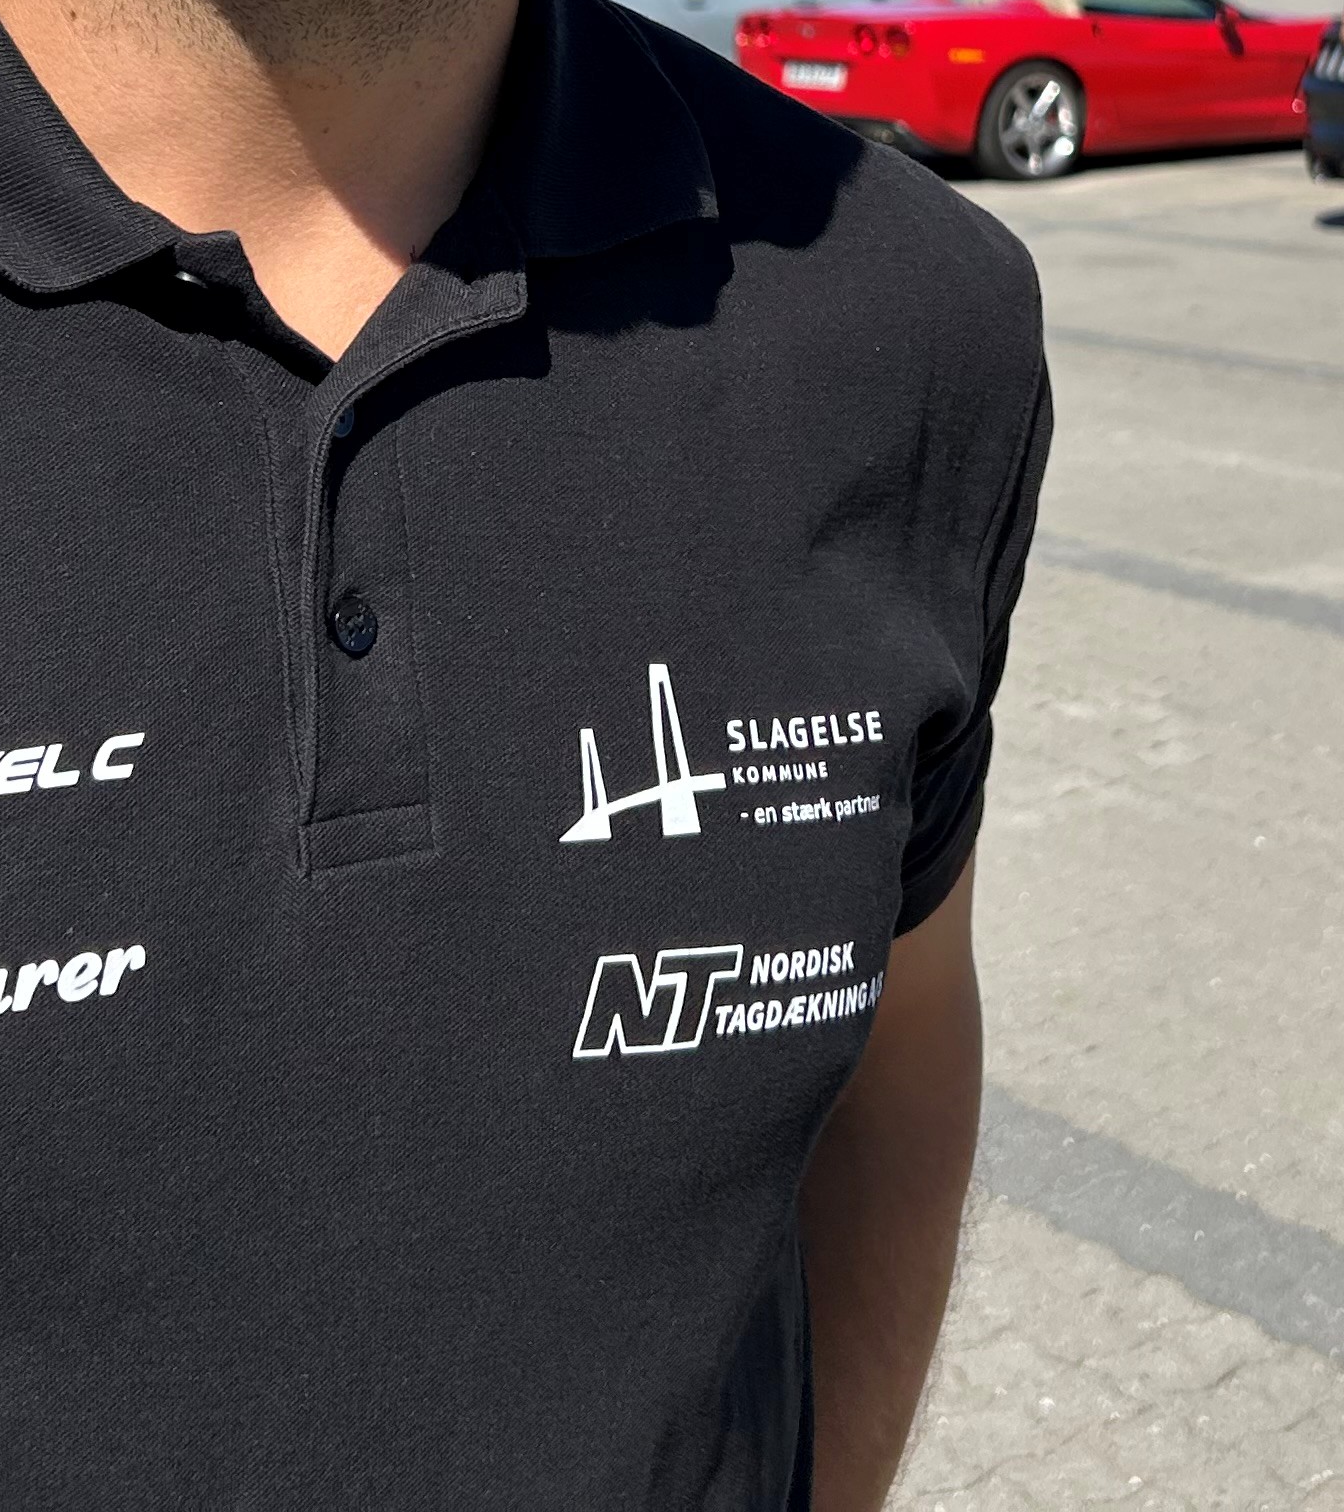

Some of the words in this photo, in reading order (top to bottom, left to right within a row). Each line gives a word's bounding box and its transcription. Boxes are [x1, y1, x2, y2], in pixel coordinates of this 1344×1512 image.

[726, 710, 884, 752] SLAGELSE
[91, 731, 146, 781] C
[732, 761, 829, 784] KOMMUNE
[754, 806, 778, 824] en
[781, 797, 833, 823] stærk
[834, 794, 881, 823] partner
[749, 941, 855, 986] NORDISK
[572, 943, 744, 1059] NT
[715, 981, 868, 1036] TAGDÆKNING
